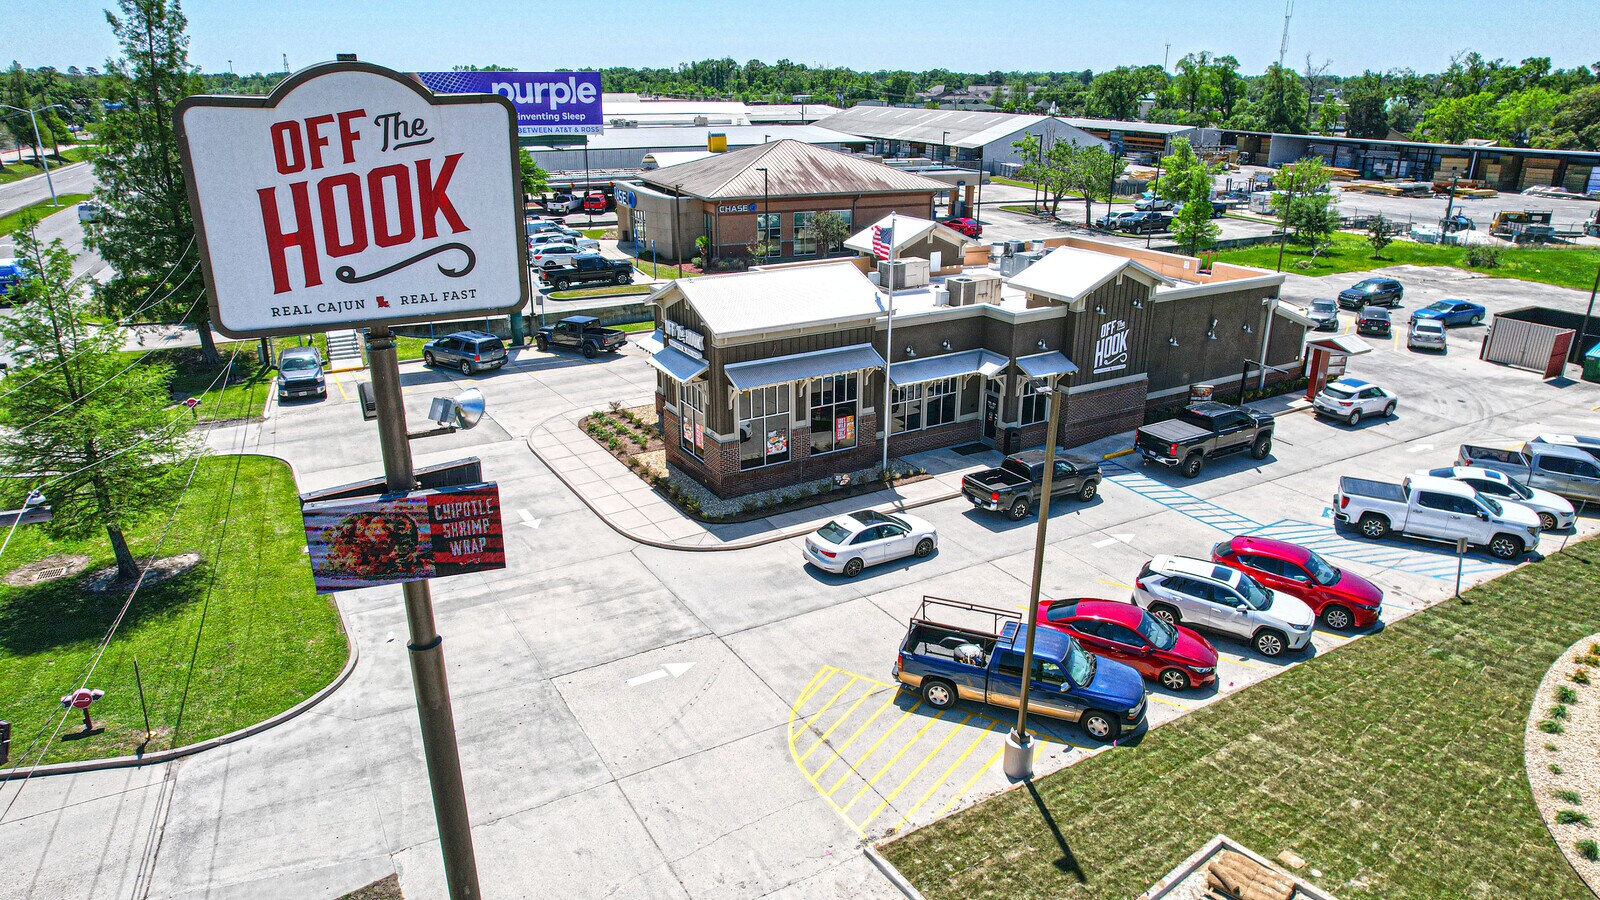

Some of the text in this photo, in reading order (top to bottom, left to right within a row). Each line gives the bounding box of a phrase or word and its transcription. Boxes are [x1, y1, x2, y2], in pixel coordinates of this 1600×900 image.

[491, 76, 597, 110] purple
[562, 112, 586, 121] Sleep
[518, 126, 553, 134] BETWEEN
[270, 108, 435, 175] OFF The
[719, 205, 748, 213] CHASE
[256, 153, 471, 294] HOOK
[400, 289, 478, 305] REAL FAST
[270, 299, 365, 317] REAL CAJUN
[1100, 319, 1117, 338] OFF
[1093, 328, 1130, 369] HOOK
[434, 498, 494, 521] CHIPOTLE
[442, 517, 490, 539] SHRIMP
[449, 537, 487, 557] WRAP
